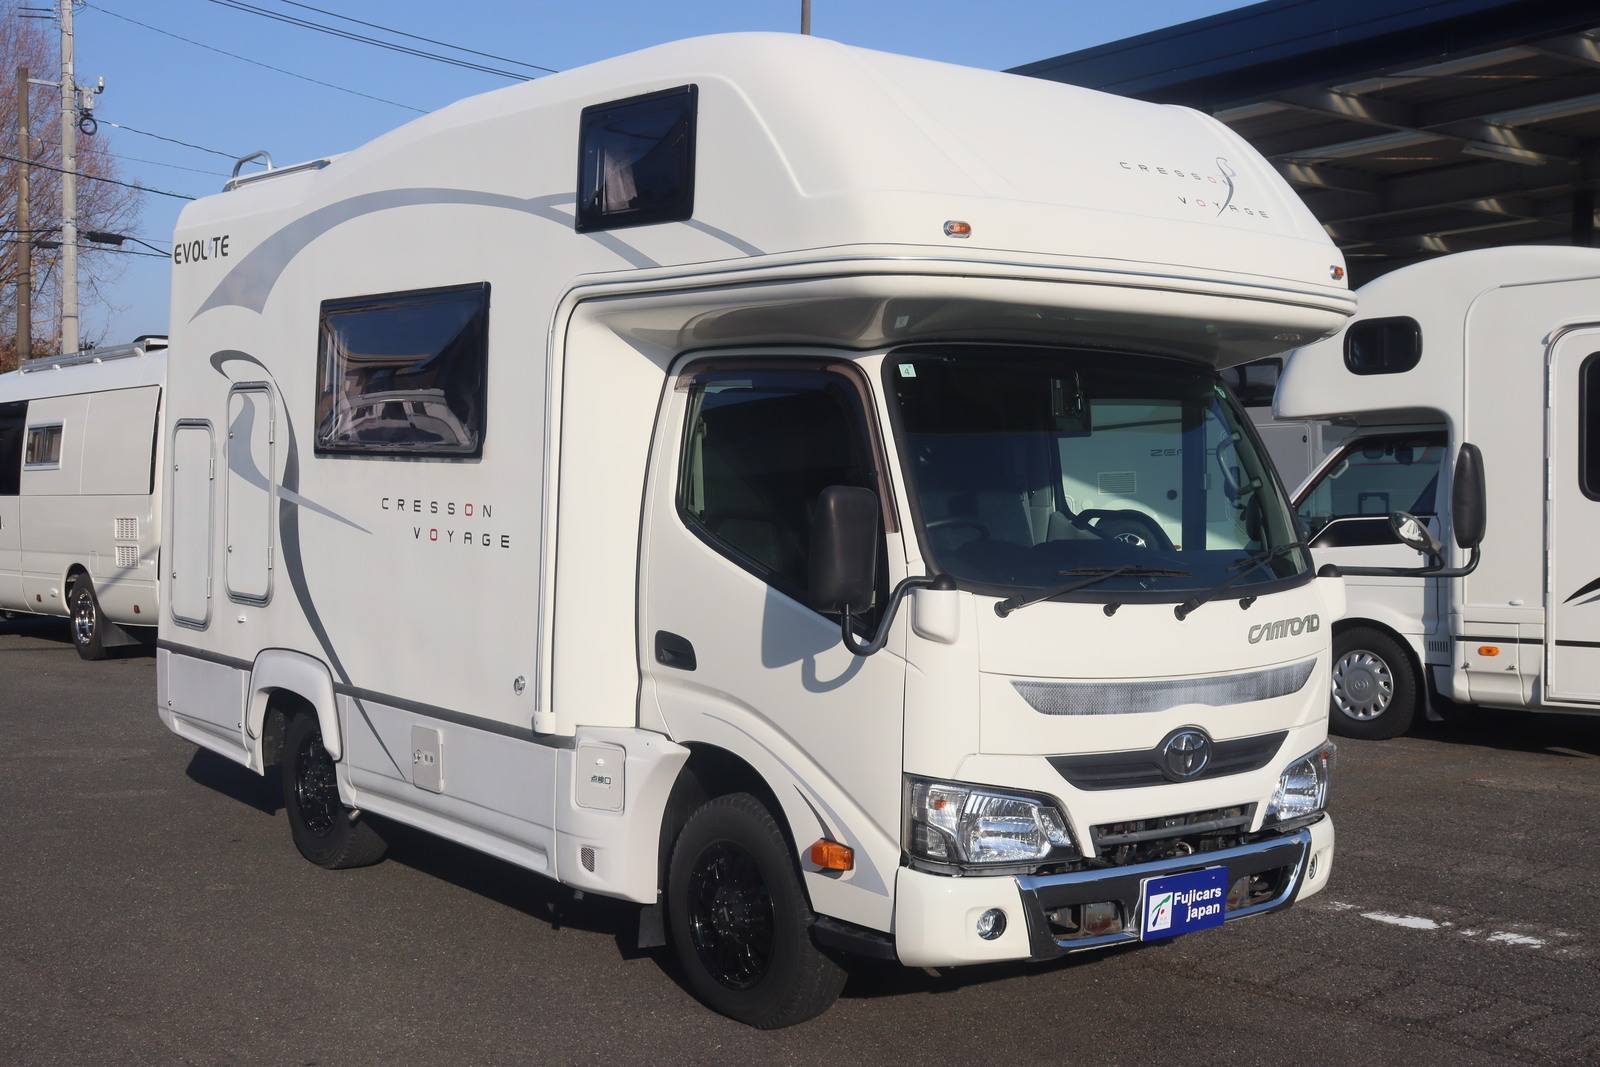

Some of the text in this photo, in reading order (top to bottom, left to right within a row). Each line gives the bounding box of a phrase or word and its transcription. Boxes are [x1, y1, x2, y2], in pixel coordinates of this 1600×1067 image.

[1178, 195, 1269, 219] VOYAGE
[381, 497, 492, 518] CRESSON
[413, 527, 510, 548] VOYAGE
[1248, 613, 1320, 644] CAMROAD
[1173, 887, 1222, 906] Fujicars
[1185, 903, 1221, 922] japan
